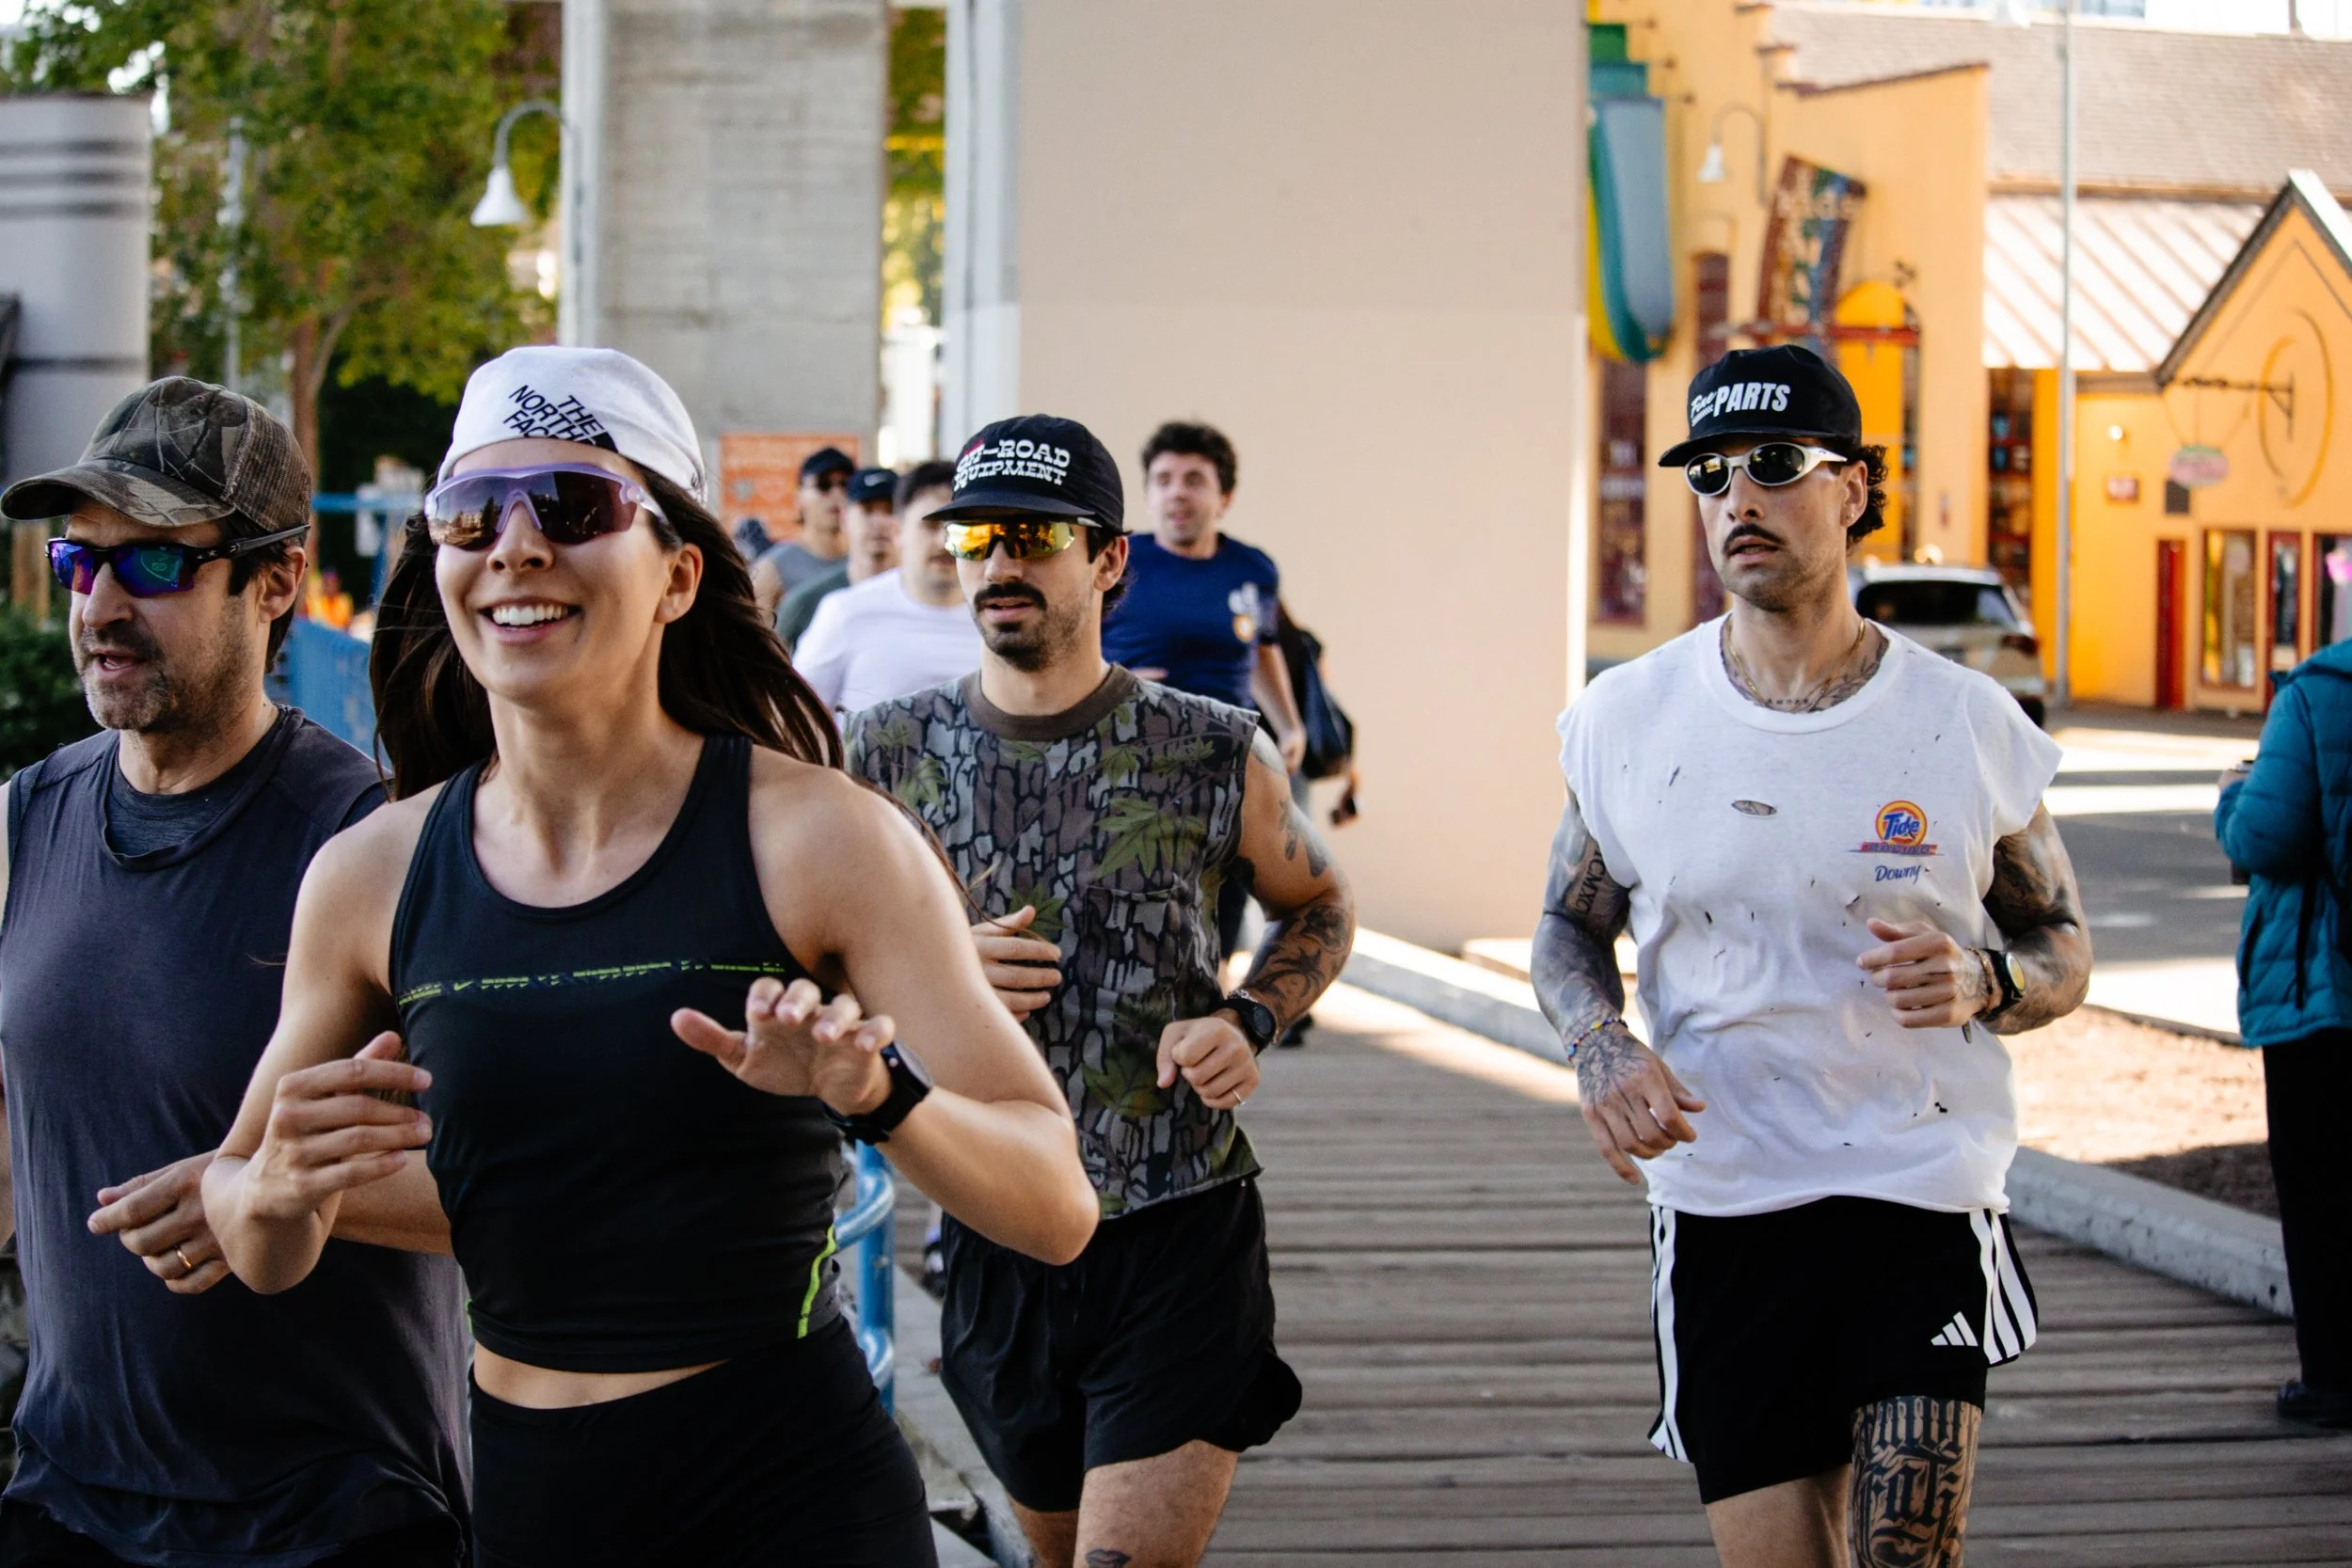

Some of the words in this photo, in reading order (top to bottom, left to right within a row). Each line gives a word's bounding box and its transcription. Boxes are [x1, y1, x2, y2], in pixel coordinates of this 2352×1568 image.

[508, 385, 585, 439] NORTH
[558, 395, 605, 436] THE
[1713, 382, 1790, 418] PARTS
[502, 410, 559, 438] FAC
[1883, 812, 1920, 840] Tide
[1875, 865, 1921, 884] Downy
